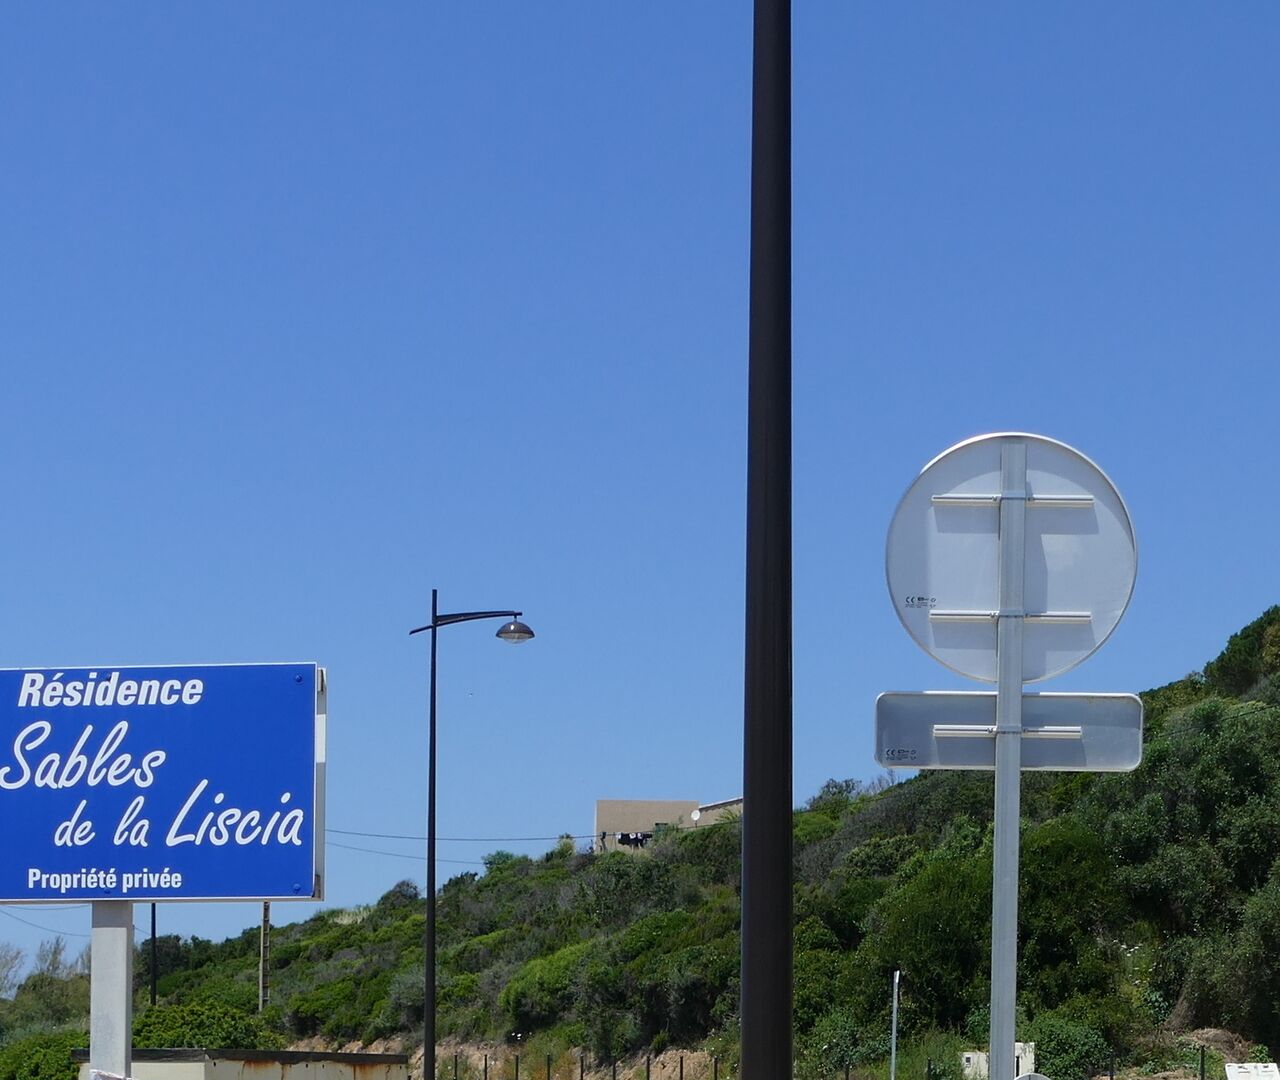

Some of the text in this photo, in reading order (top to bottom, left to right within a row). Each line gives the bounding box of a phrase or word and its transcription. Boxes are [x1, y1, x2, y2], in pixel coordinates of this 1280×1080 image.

[18, 671, 204, 708] Résidence
[54, 779, 303, 847] de la Liscia
[28, 867, 182, 893] Propriété privée
